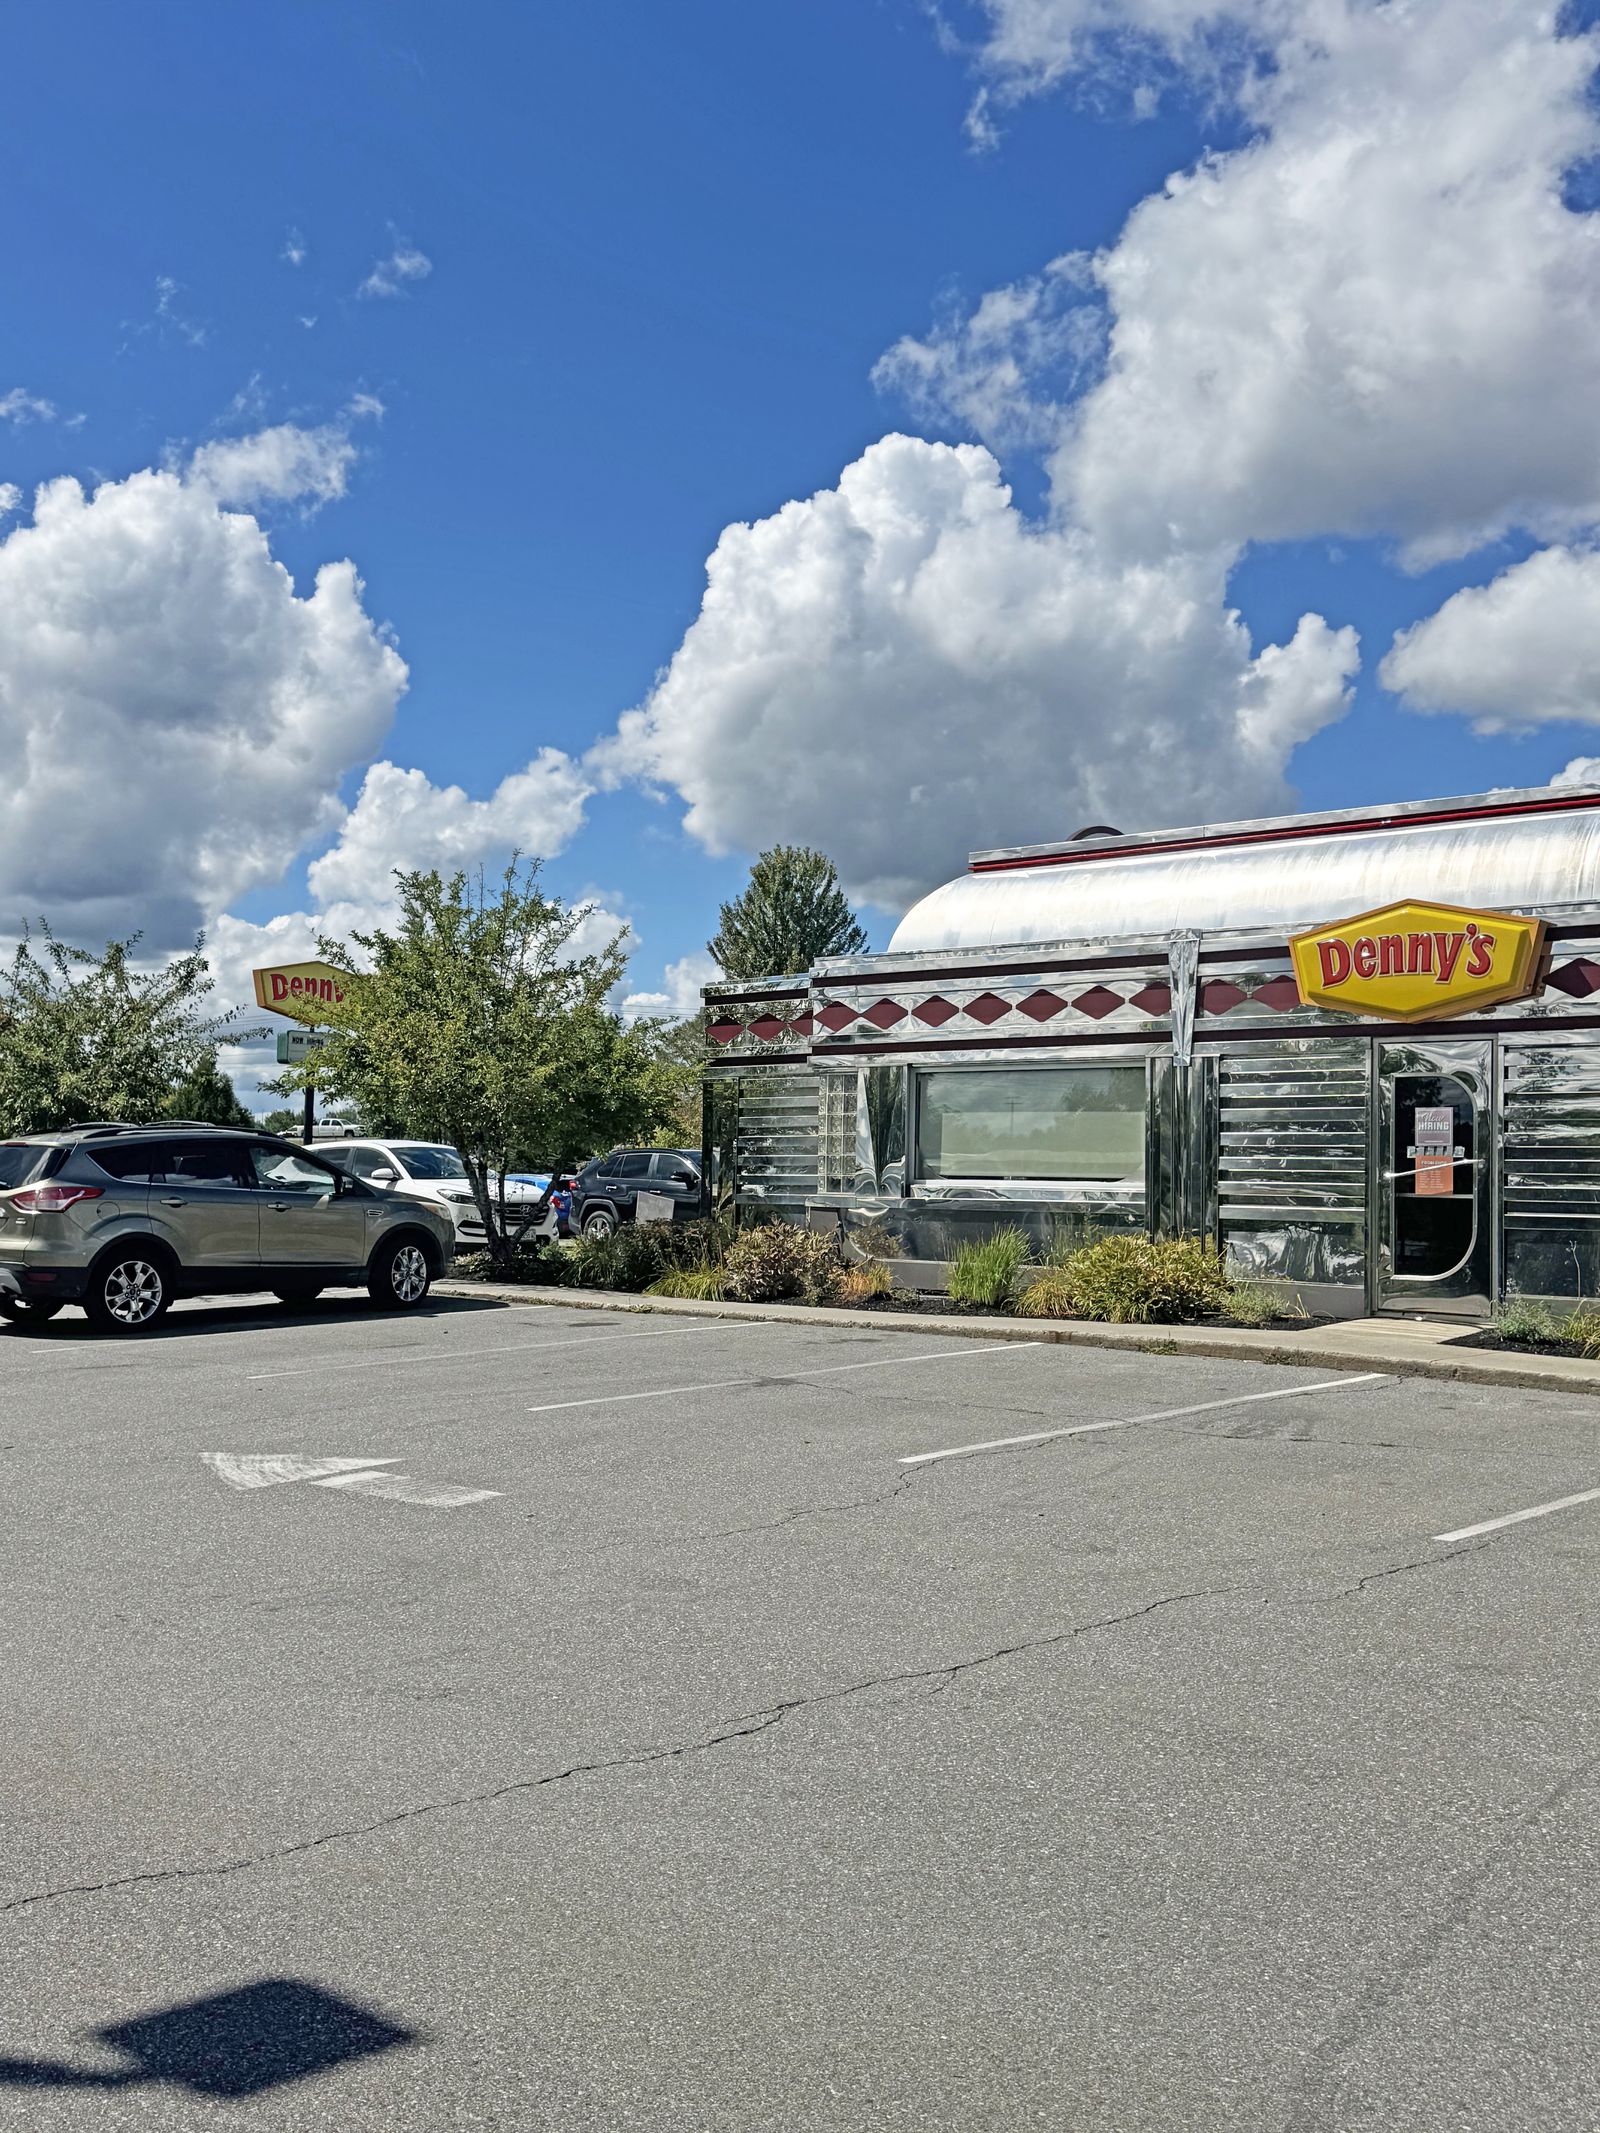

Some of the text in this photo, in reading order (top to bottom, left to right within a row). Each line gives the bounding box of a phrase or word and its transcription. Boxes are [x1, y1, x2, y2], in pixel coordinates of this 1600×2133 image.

[1316, 923, 1496, 989] Denny's
[1420, 1111, 1446, 1121] Now
[1418, 1121, 1449, 1131] HIRING
